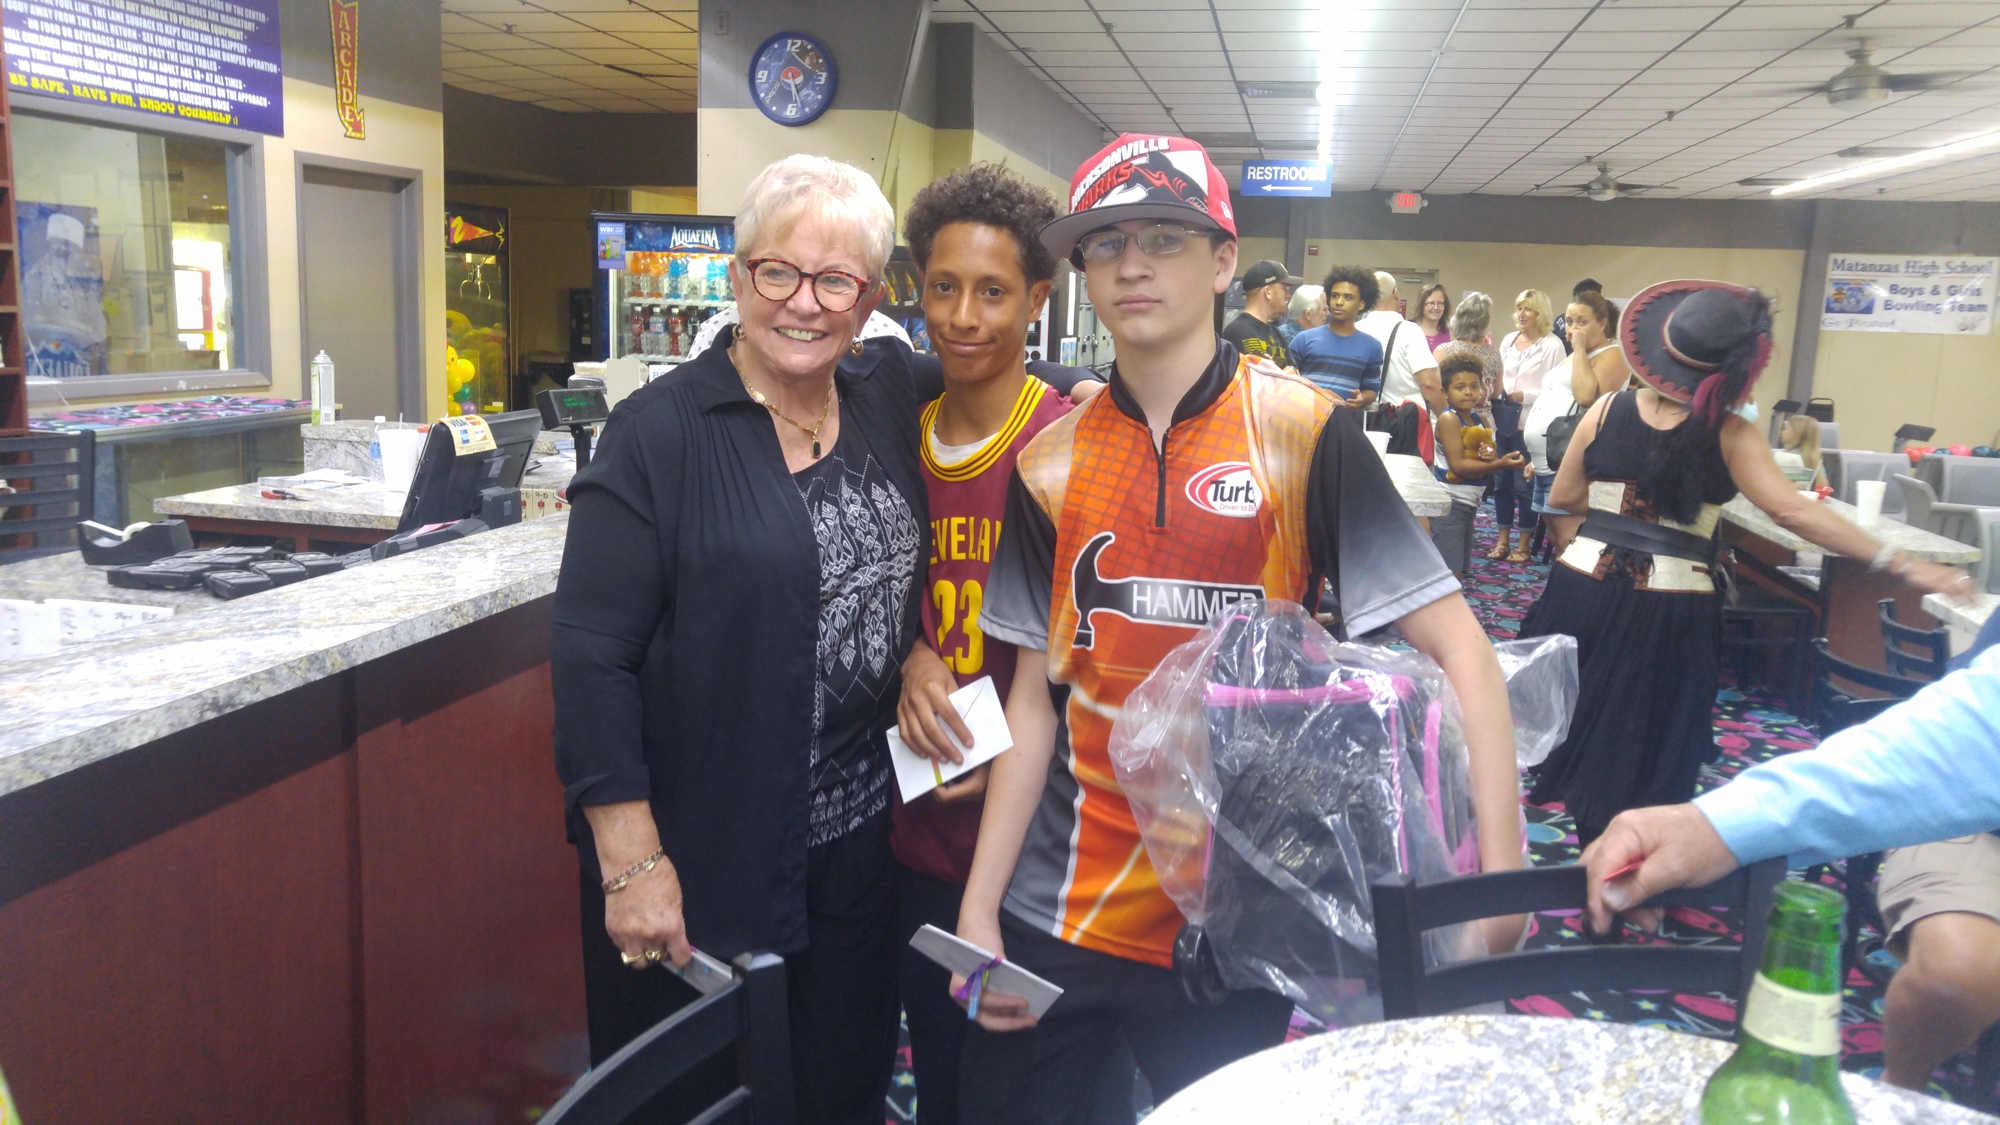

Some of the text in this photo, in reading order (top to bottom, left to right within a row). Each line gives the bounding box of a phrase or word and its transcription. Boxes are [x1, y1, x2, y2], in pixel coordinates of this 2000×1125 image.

[126, 1, 139, 14] ANY
[140, 4, 168, 21] DAMAGE
[169, 12, 177, 24] TO
[178, 14, 210, 32] PERSONAL
[211, 23, 243, 41] EQUIPMENT
[187, 4, 207, 19] SHOES
[208, 10, 219, 21] ARE
[220, 13, 256, 32] MANDATORY
[225, 2, 232, 13] OF
[233, 4, 244, 17] THE
[245, 7, 266, 22] CENTER
[29, 3, 52, 20] AWAY
[53, 9, 76, 25] FROM
[76, 15, 91, 29] THE
[91, 18, 108, 33] BALL
[109, 23, 137, 40] RETURN
[142, 31, 154, 44] SEE
[155, 33, 175, 49] FRONT
[176, 39, 193, 53] DESK
[194, 43, 206, 57] FOR
[206, 47, 221, 60] LANE
[221, 50, 246, 67] BUMPER
[246, 57, 277, 74] OPERATION
[92, 5, 106, 19] THE
[107, 9, 124, 23] LANE
[125, 13, 156, 32] SURFACE
[156, 21, 163, 33] IS
[164, 23, 180, 37] KEPT
[181, 28, 199, 42] OILED
[200, 33, 213, 46] AND
[213, 36, 220, 48] IS
[221, 38, 247, 54] SLIPPERY
[27, 17, 217, 72] NO FOOD OR BEVERAGES ALLOWED PAST THE LANE TABLES
[786, 39, 802, 52] 12
[60, 40, 82, 55] MUST
[83, 45, 94, 58] BE
[94, 47, 137, 67] SUPERVISED
[138, 56, 147, 69] BY
[148, 59, 158, 72] AN
[158, 61, 179, 77] ADULT
[179, 66, 192, 80] AGE
[206, 72, 213, 83] AT
[214, 74, 224, 86] ALL
[224, 76, 243, 90] TIMES
[338, 9, 355, 123] ARCADE
[755, 70, 768, 83] 9
[116, 65, 137, 81] THEIR
[137, 70, 155, 84] OWN
[155, 73, 168, 87] ARE
[168, 76, 181, 90] NOT
[182, 79, 217, 97] PERMITTED
[217, 87, 226, 99] ON
[226, 89, 237, 102] THE
[237, 91, 268, 108] APPROACH
[815, 72, 827, 85] 3
[9, 72, 28, 87] BE
[72, 84, 107, 102] HAVE
[139, 97, 175, 114] ENJOY
[178, 104, 231, 125] YOURSELF
[169, 89, 179, 103] OR
[179, 91, 212, 108] EXCESSIVE
[212, 97, 230, 112] NOISE
[786, 103, 797, 116] 6
[1070, 137, 1170, 214] JACKSONVILLE
[1247, 166, 1328, 182] RESTROOMS
[1397, 193, 1417, 208] EXIT
[669, 225, 721, 250] AQUAFINA
[1832, 258, 1993, 278] Matanzas High School
[1889, 284, 1982, 298] Boys & Girls
[1884, 300, 1988, 314] Bowling Team
[1220, 503, 1239, 511] Driven
[930, 516, 1002, 565] EVELA
[932, 579, 984, 675] 23
